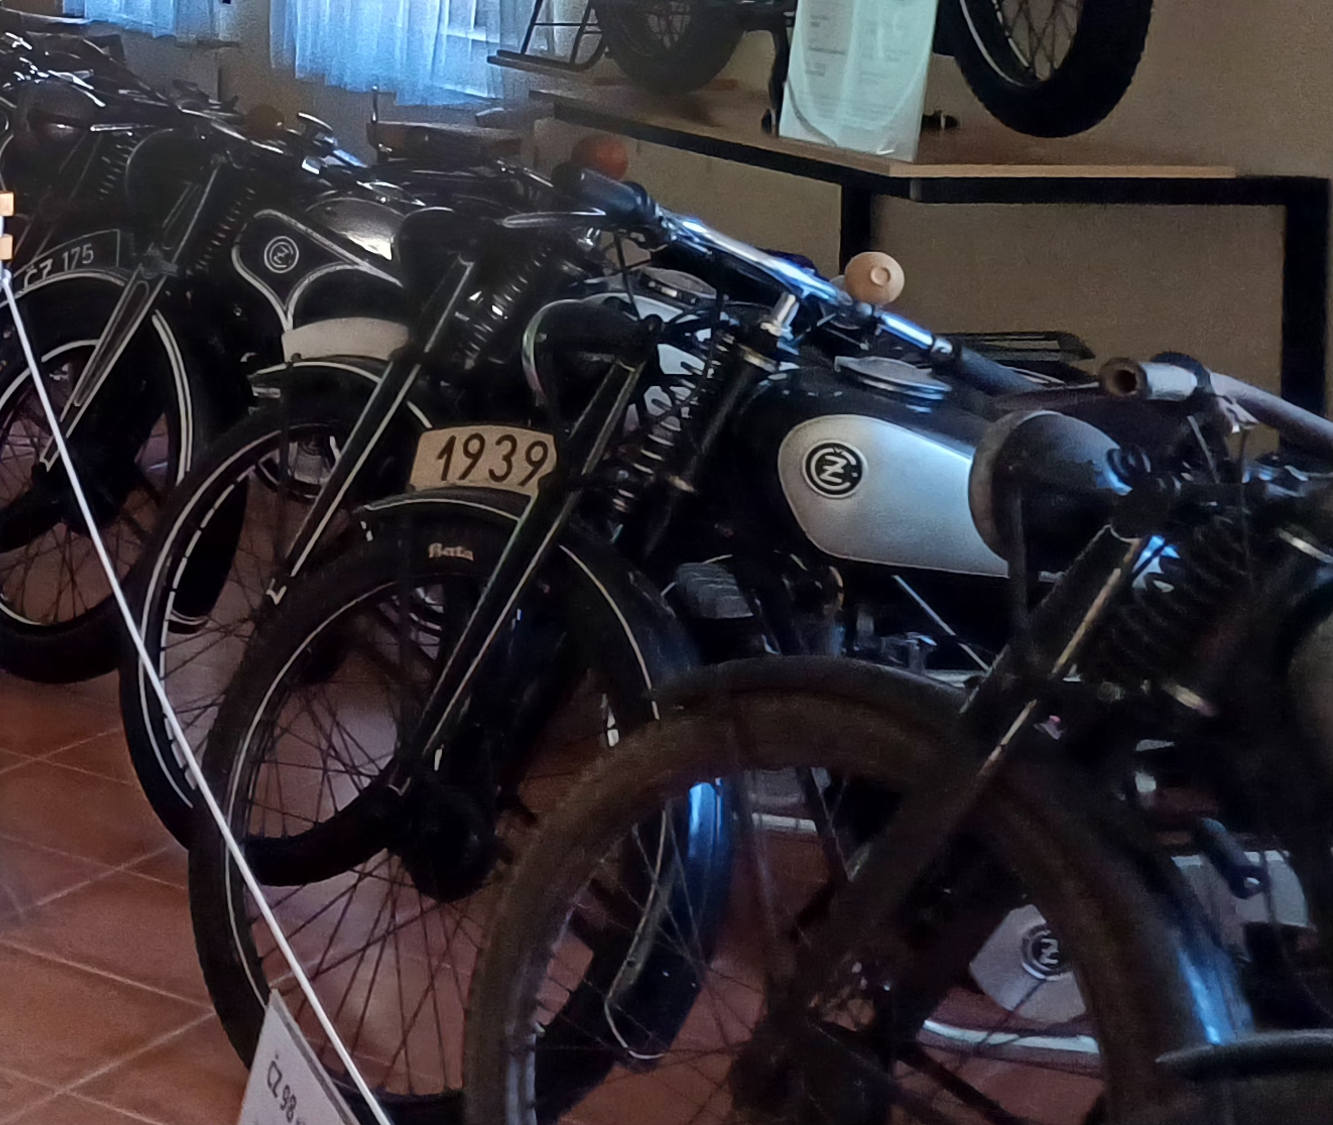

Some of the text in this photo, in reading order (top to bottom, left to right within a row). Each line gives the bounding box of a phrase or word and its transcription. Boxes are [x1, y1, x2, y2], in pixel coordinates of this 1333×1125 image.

[62, 243, 94, 273] 175
[436, 432, 549, 487] 1939
[280, 1084, 298, 1124] 98
